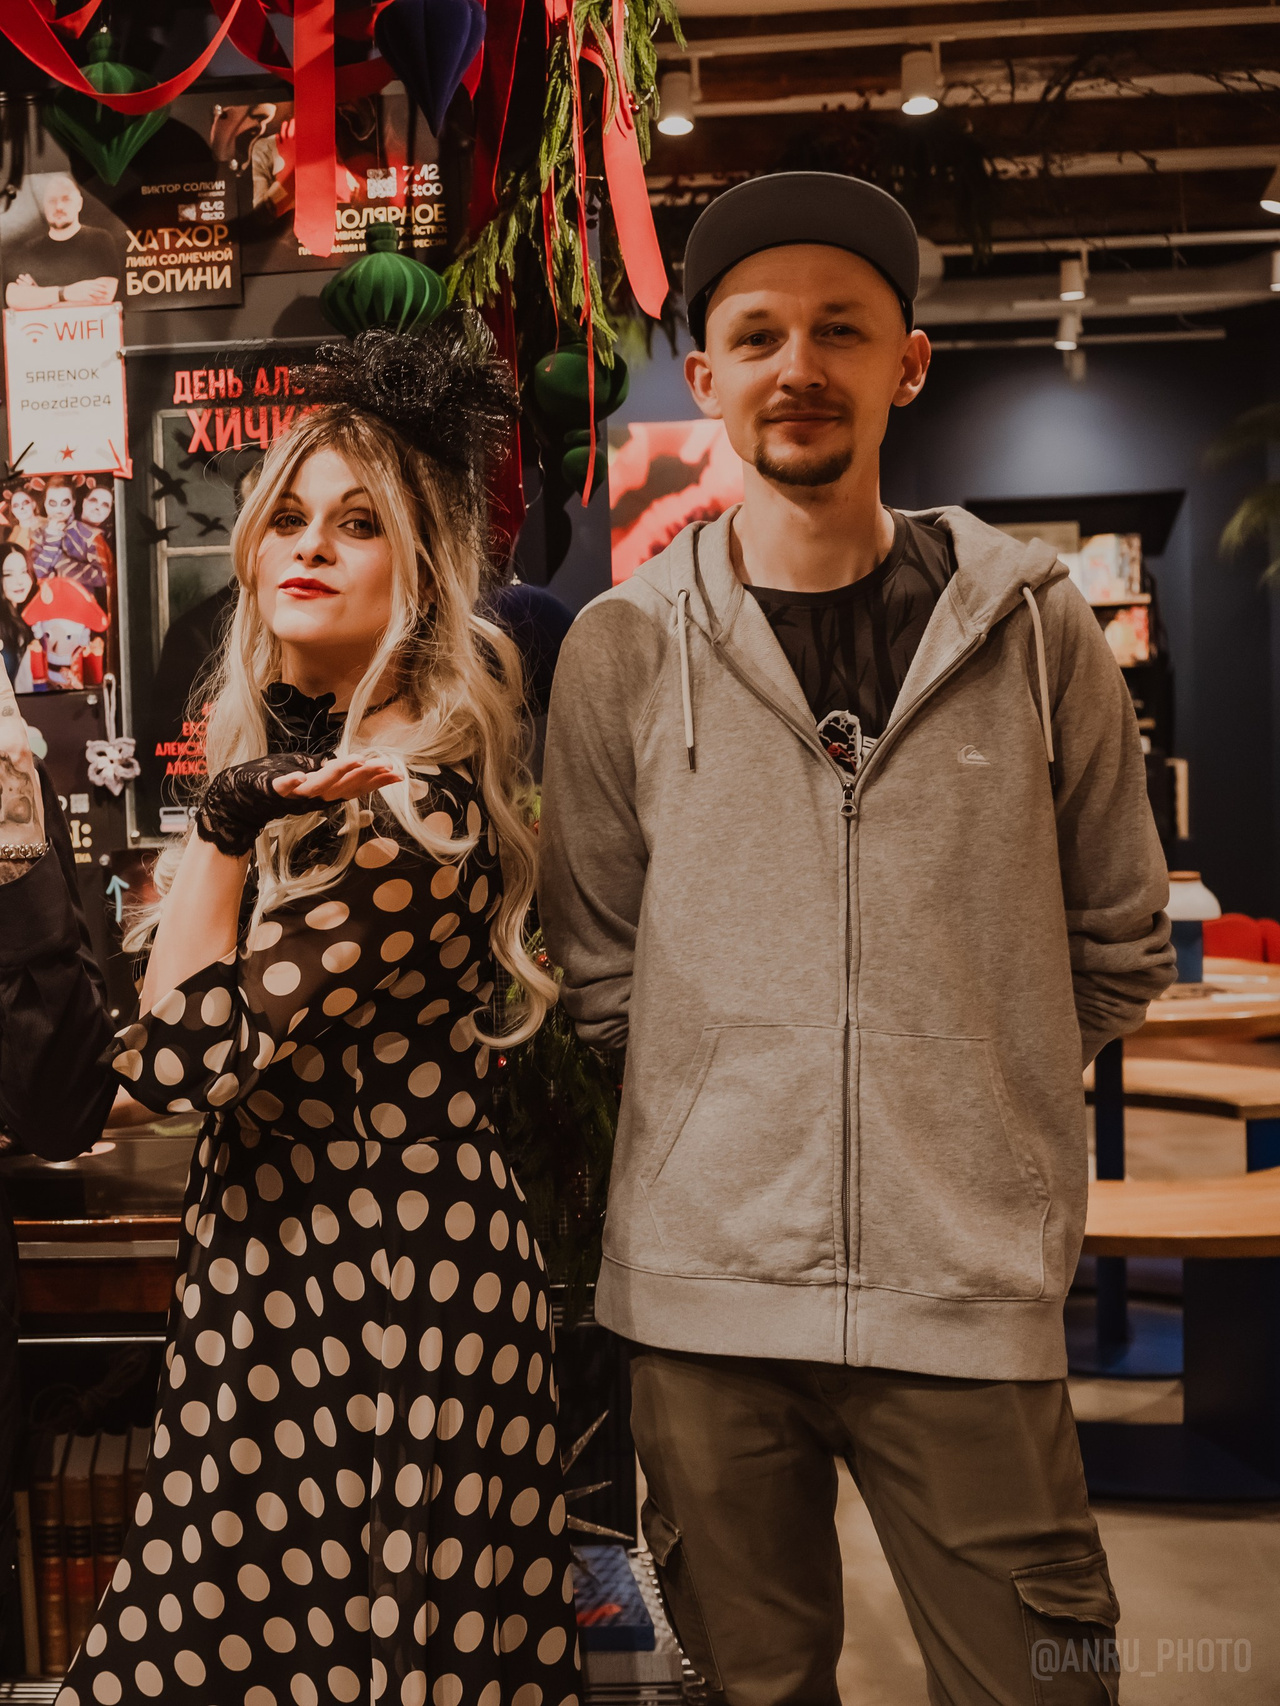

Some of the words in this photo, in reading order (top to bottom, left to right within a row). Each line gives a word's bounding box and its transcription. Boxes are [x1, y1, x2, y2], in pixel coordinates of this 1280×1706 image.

[141, 183, 181, 195] ВИКТОР
[183, 180, 226, 192] СОЛКИН
[125, 255, 157, 268] ЛИКИ
[159, 247, 233, 266] СОЛНЕЧНОЙ
[126, 264, 232, 296] БОГИНИ
[54, 319, 104, 341] WIFI
[172, 368, 244, 405] ДЕНЬ
